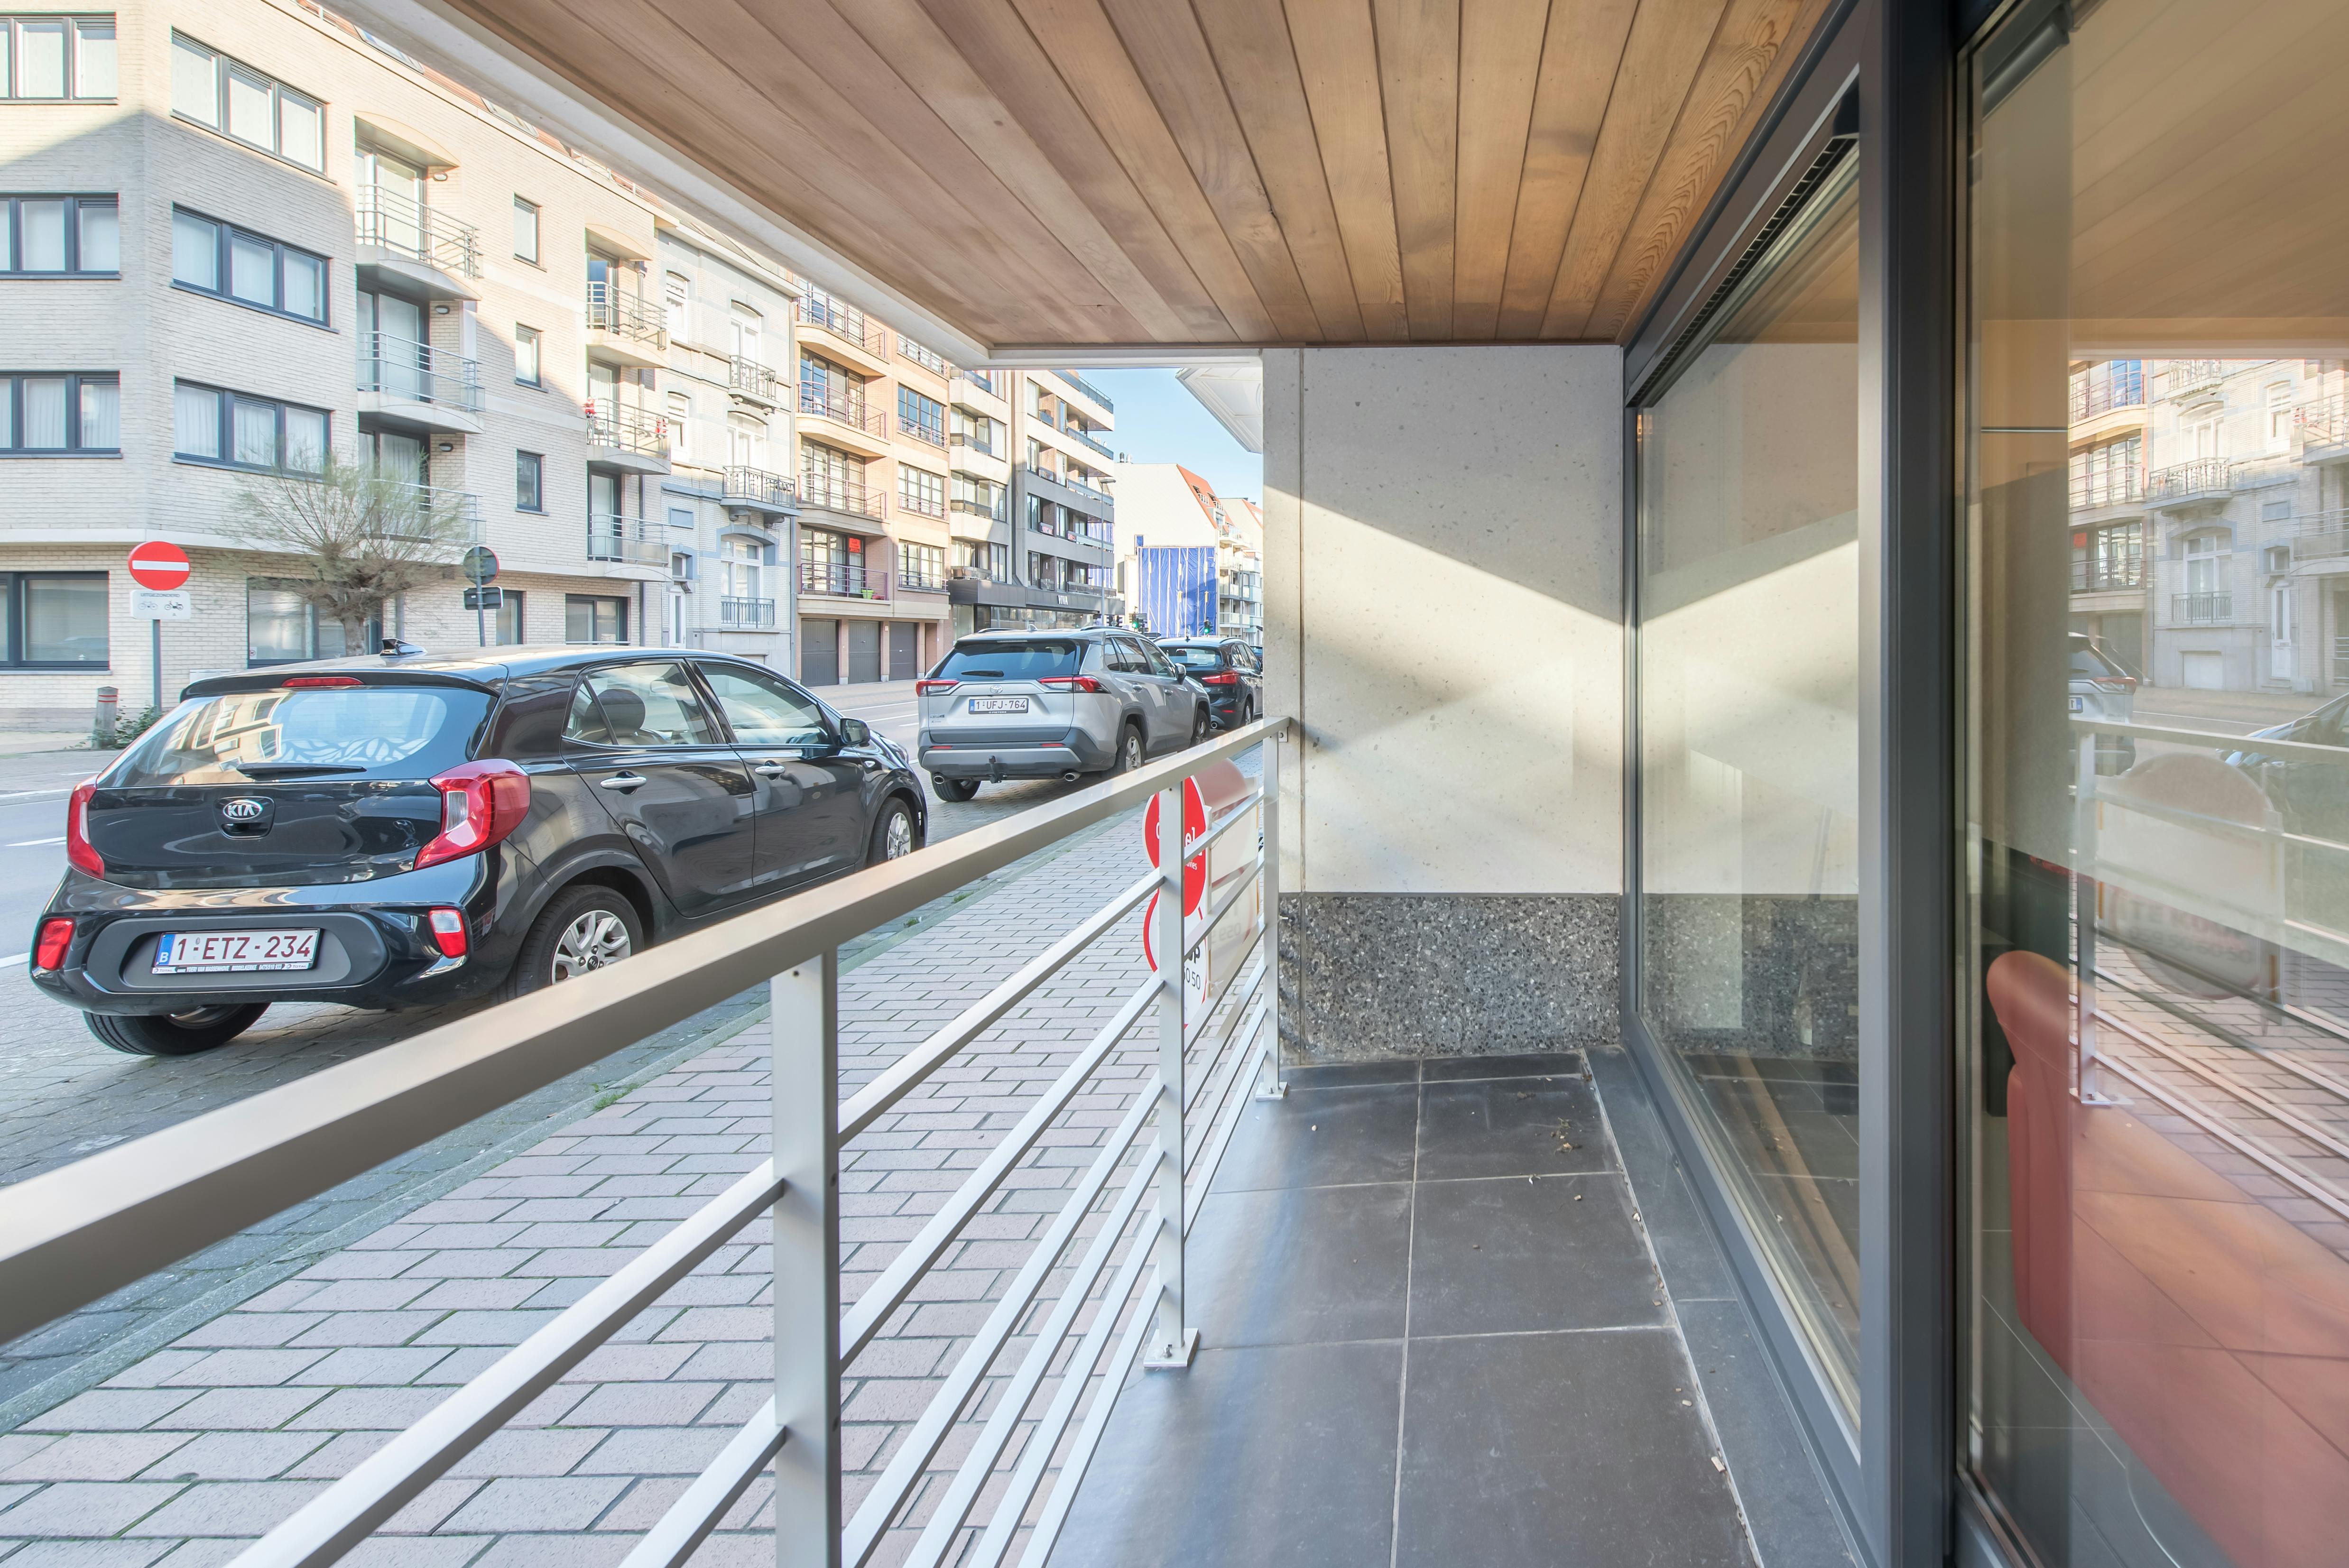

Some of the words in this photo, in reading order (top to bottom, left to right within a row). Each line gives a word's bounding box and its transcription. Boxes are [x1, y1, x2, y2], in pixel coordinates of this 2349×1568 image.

[1058, 595, 1068, 605] VIVA
[976, 700, 1026, 710] 1-UFJ-764
[228, 804, 256, 816] KIA
[159, 951, 169, 963] B
[178, 935, 314, 961] 1-ETZ-234
[589, 958, 598, 968] KIA
[1192, 971, 1201, 990] 50
